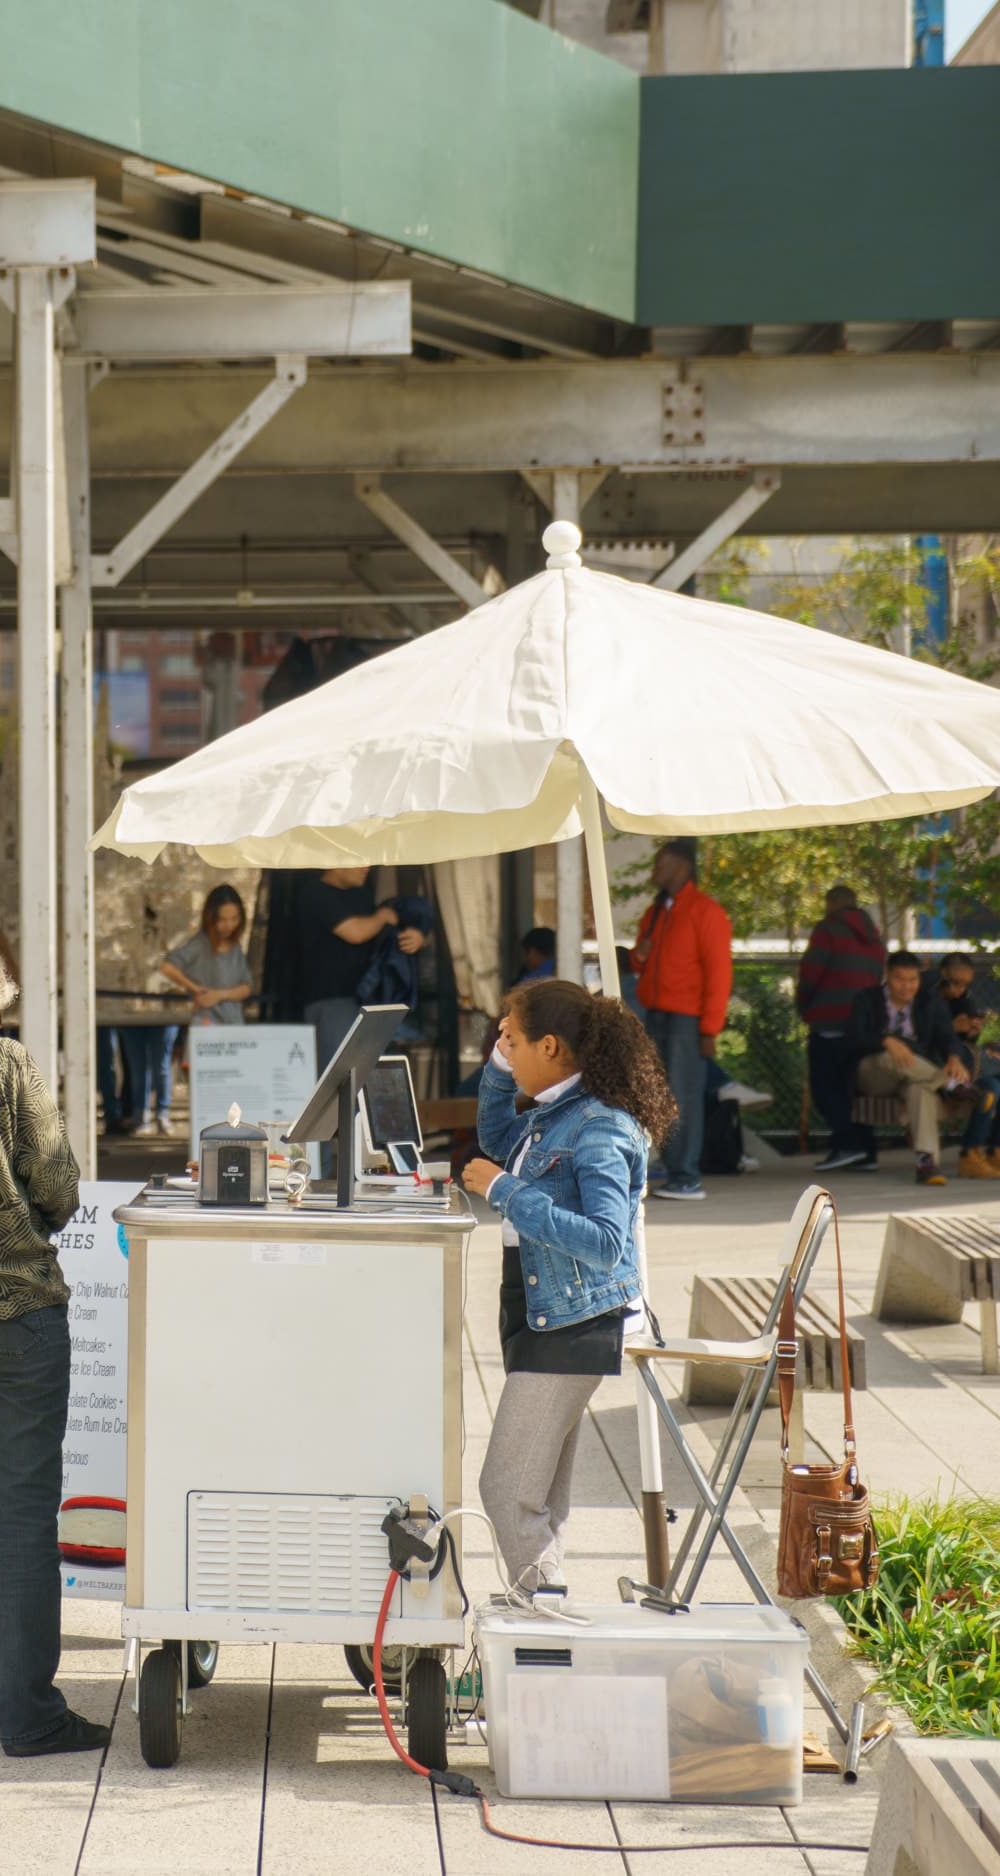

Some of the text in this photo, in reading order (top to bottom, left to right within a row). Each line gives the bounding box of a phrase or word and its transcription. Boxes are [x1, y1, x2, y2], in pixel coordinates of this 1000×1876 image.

[55, 1233, 95, 1250] HES
[76, 1282, 92, 1300] Chip
[94, 1282, 119, 1298] Walnut
[74, 1304, 98, 1320] Cream
[72, 1336, 106, 1353] Meltcakes
[81, 1360, 92, 1376] Ice
[93, 1360, 116, 1376] Cream
[89, 1392, 118, 1410] Cookies
[84, 1415, 100, 1432] Rum
[101, 1416, 113, 1433] Ice
[114, 1417, 128, 1434] Cre
